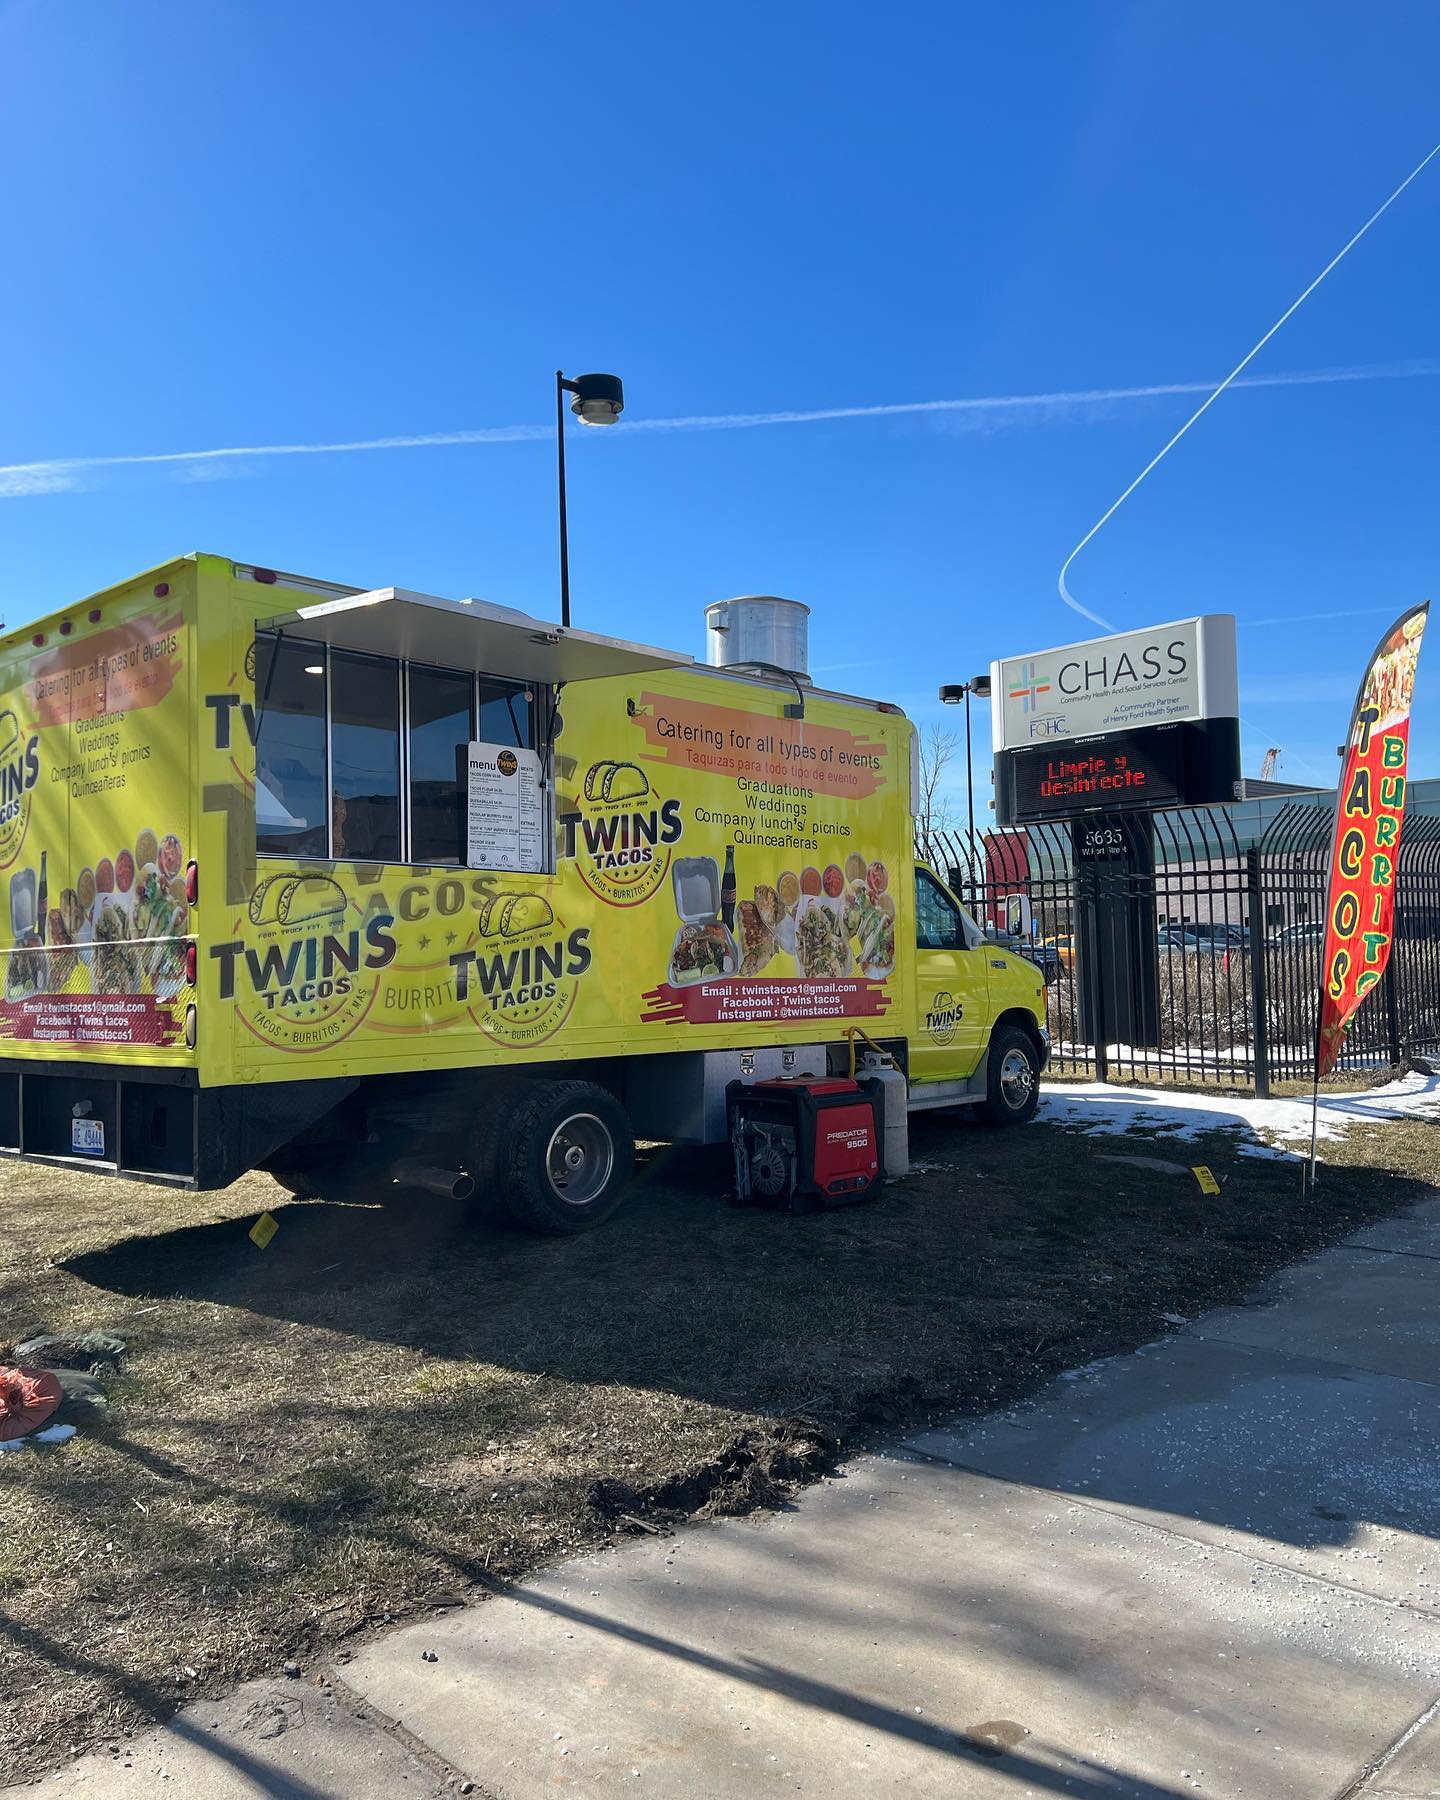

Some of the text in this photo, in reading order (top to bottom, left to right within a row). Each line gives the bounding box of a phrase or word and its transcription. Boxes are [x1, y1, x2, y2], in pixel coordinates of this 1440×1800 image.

[36, 674, 69, 700] Catering
[72, 666, 86, 688] for
[130, 643, 140, 667] of
[143, 634, 177, 662] events
[1058, 641, 1187, 695] CHASS
[1060, 676, 1189, 705] Community Health And Social Services Center
[1103, 704, 1190, 724] of Henry Ford Health System
[1120, 701, 1156, 713] Community
[1156, 696, 1180, 706] Partner
[75, 709, 125, 734] Graduations
[79, 732, 119, 754] Weddings
[656, 717, 881, 769] Catering for all types of events
[0, 735, 39, 805] INS
[51, 761, 86, 783] Company
[121, 744, 151, 768] picnics
[469, 760, 496, 771] menu
[685, 748, 858, 785] Taquizas para todo tipo de evento
[71, 774, 126, 798] Quinceañeras
[737, 776, 814, 799] Graduations
[1041, 770, 1145, 796] Desinfecte
[745, 795, 807, 817] Weddings
[560, 799, 682, 858] TWINS
[694, 807, 756, 830] Company
[812, 821, 851, 836] picnics
[733, 829, 818, 850] Quinceañeras
[1085, 828, 1123, 846] 5635
[593, 847, 653, 870] TACOS
[1330, 704, 1380, 1001] TACOS
[588, 869, 607, 892] TACOS
[613, 884, 646, 899] BURRITOS
[653, 858, 664, 875] MAS
[1346, 735, 1406, 1027] BURRIT
[209, 915, 397, 1000] TWINS
[449, 928, 592, 1001] TWINS
[262, 977, 351, 1010] TACOS
[384, 970, 478, 1011] BURRITS
[488, 982, 557, 1010] TACOS
[701, 986, 732, 997] Email
[742, 983, 857, 996] twinstacos1@gmail.com
[723, 996, 774, 1008] Facebook
[783, 995, 812, 1006] Twins
[814, 995, 840, 1005] tacos
[23, 1002, 43, 1013] Email
[36, 1014, 72, 1026] Facebook
[79, 1015, 104, 1026] Twins
[105, 1015, 129, 1026] tacos
[253, 988, 368, 1043] TACOS BURRITOS Y MAS
[481, 992, 569, 1040] TACOS BURRITOS Y MAS
[718, 1008, 772, 1021] Instagram
[779, 1004, 845, 1018] @twinstacos1
[926, 1003, 963, 1030] TWINS
[33, 1027, 70, 1041] Instagram
[826, 1128, 868, 1140] PREDATOR
[846, 1138, 868, 1149] 9500
